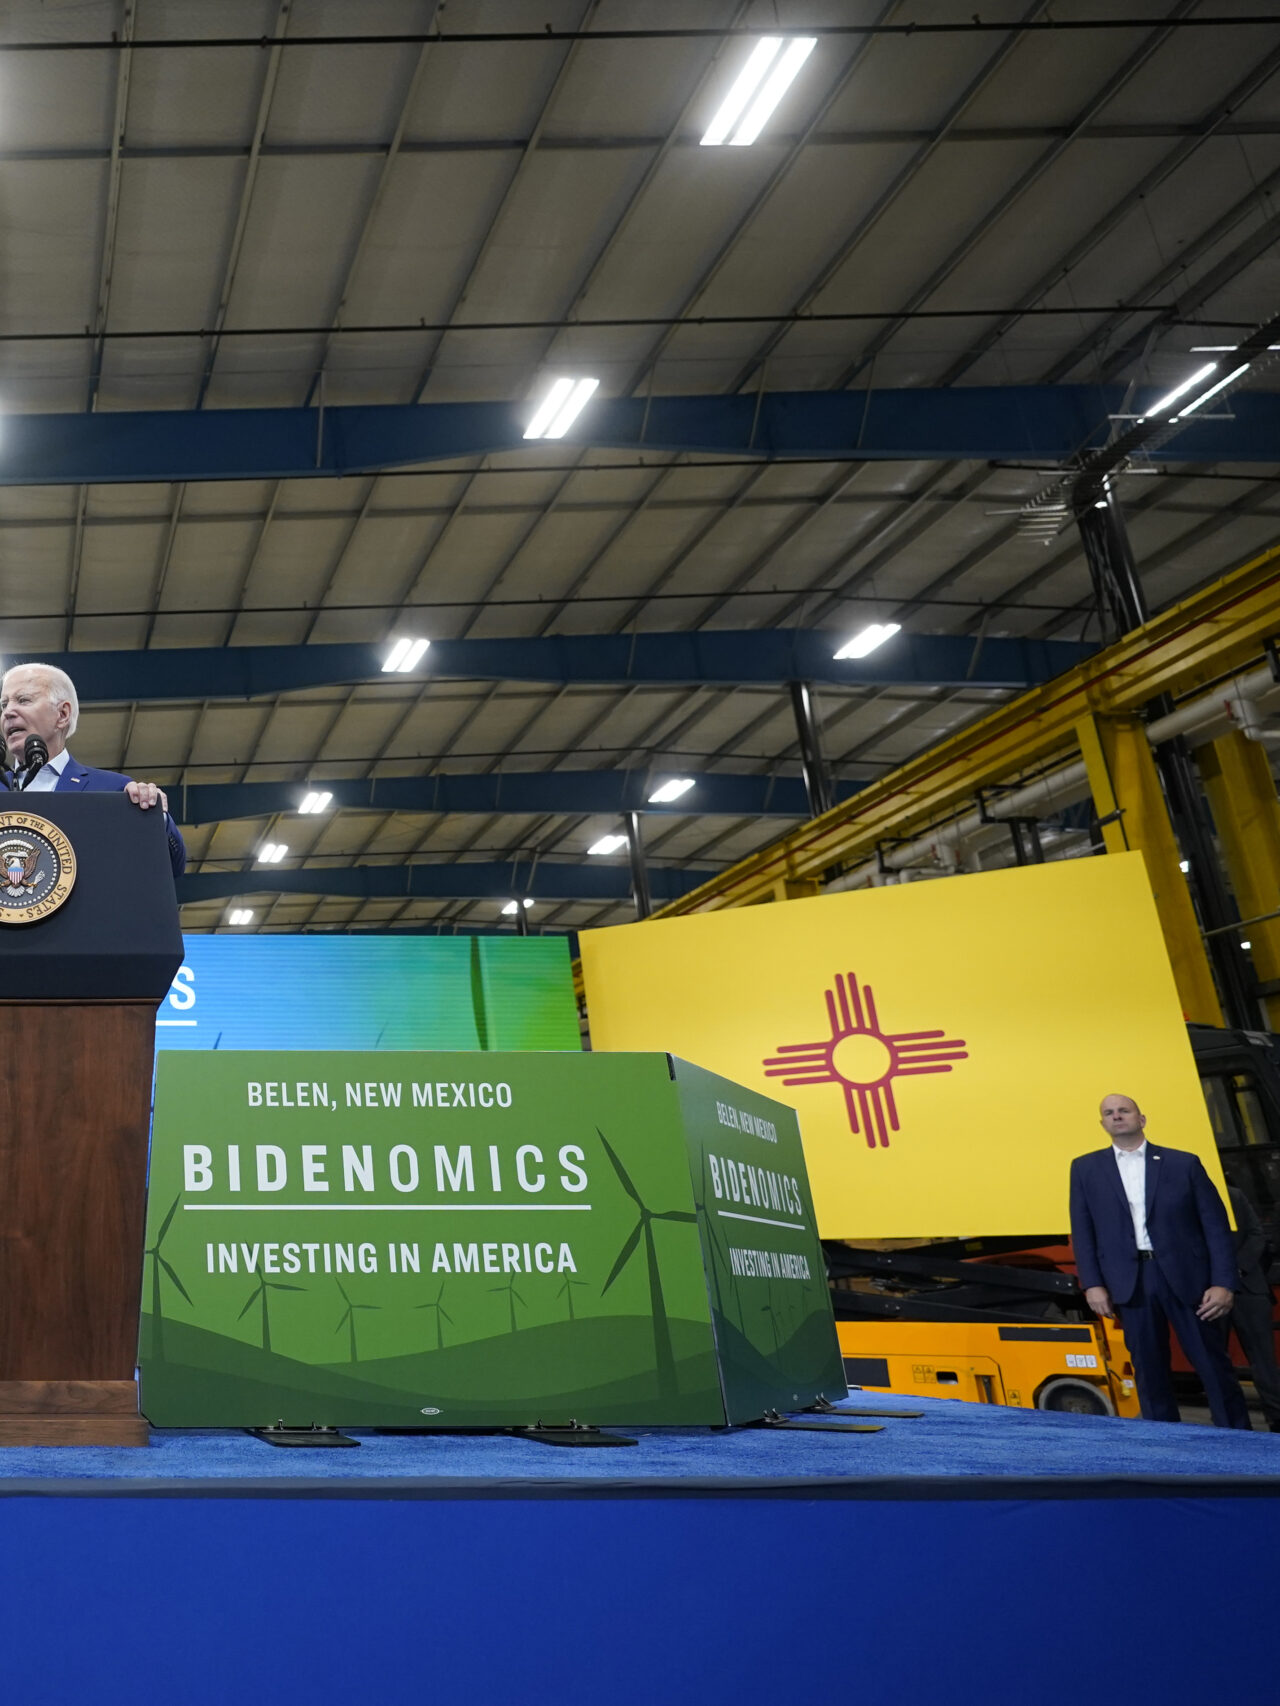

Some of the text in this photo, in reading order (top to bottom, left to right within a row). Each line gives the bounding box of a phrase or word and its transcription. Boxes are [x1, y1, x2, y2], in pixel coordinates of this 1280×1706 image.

[16, 816, 28, 825] OF
[30, 819, 45, 831] THE
[47, 829, 73, 875] UNITED
[25, 884, 68, 918] STATES
[247, 1081, 513, 1112] BELEN, NEW MEXICO
[716, 1101, 778, 1144] BELEN, NEW MEXICO
[182, 1144, 589, 1193] BIDENOMICS
[708, 1153, 803, 1216] BIDENOMICS
[206, 1242, 578, 1274] INVESTING IN AMERICA
[729, 1248, 811, 1280] INVESTING IN AMERICA
